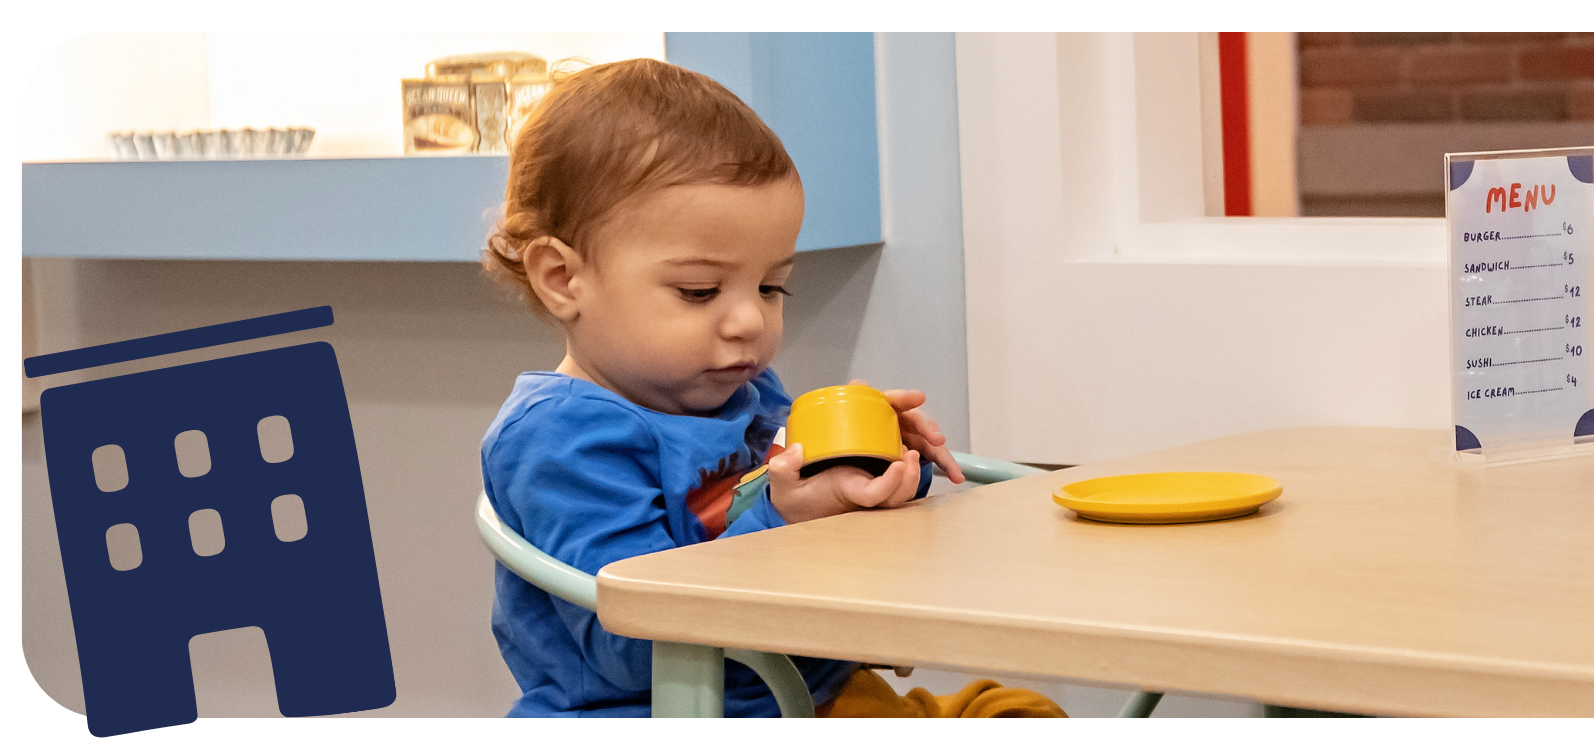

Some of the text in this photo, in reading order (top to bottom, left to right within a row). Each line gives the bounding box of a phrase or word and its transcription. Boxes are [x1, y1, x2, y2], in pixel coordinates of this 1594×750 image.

[1486, 183, 1556, 213] MENU
[1562, 222, 1574, 235] $6
[1563, 251, 1575, 265] $5
[1564, 284, 1581, 297] $12
[1565, 314, 1581, 328] $12
[1565, 343, 1583, 357] $10
[1467, 389, 1481, 400] ICE
[1566, 374, 1577, 387] $4
